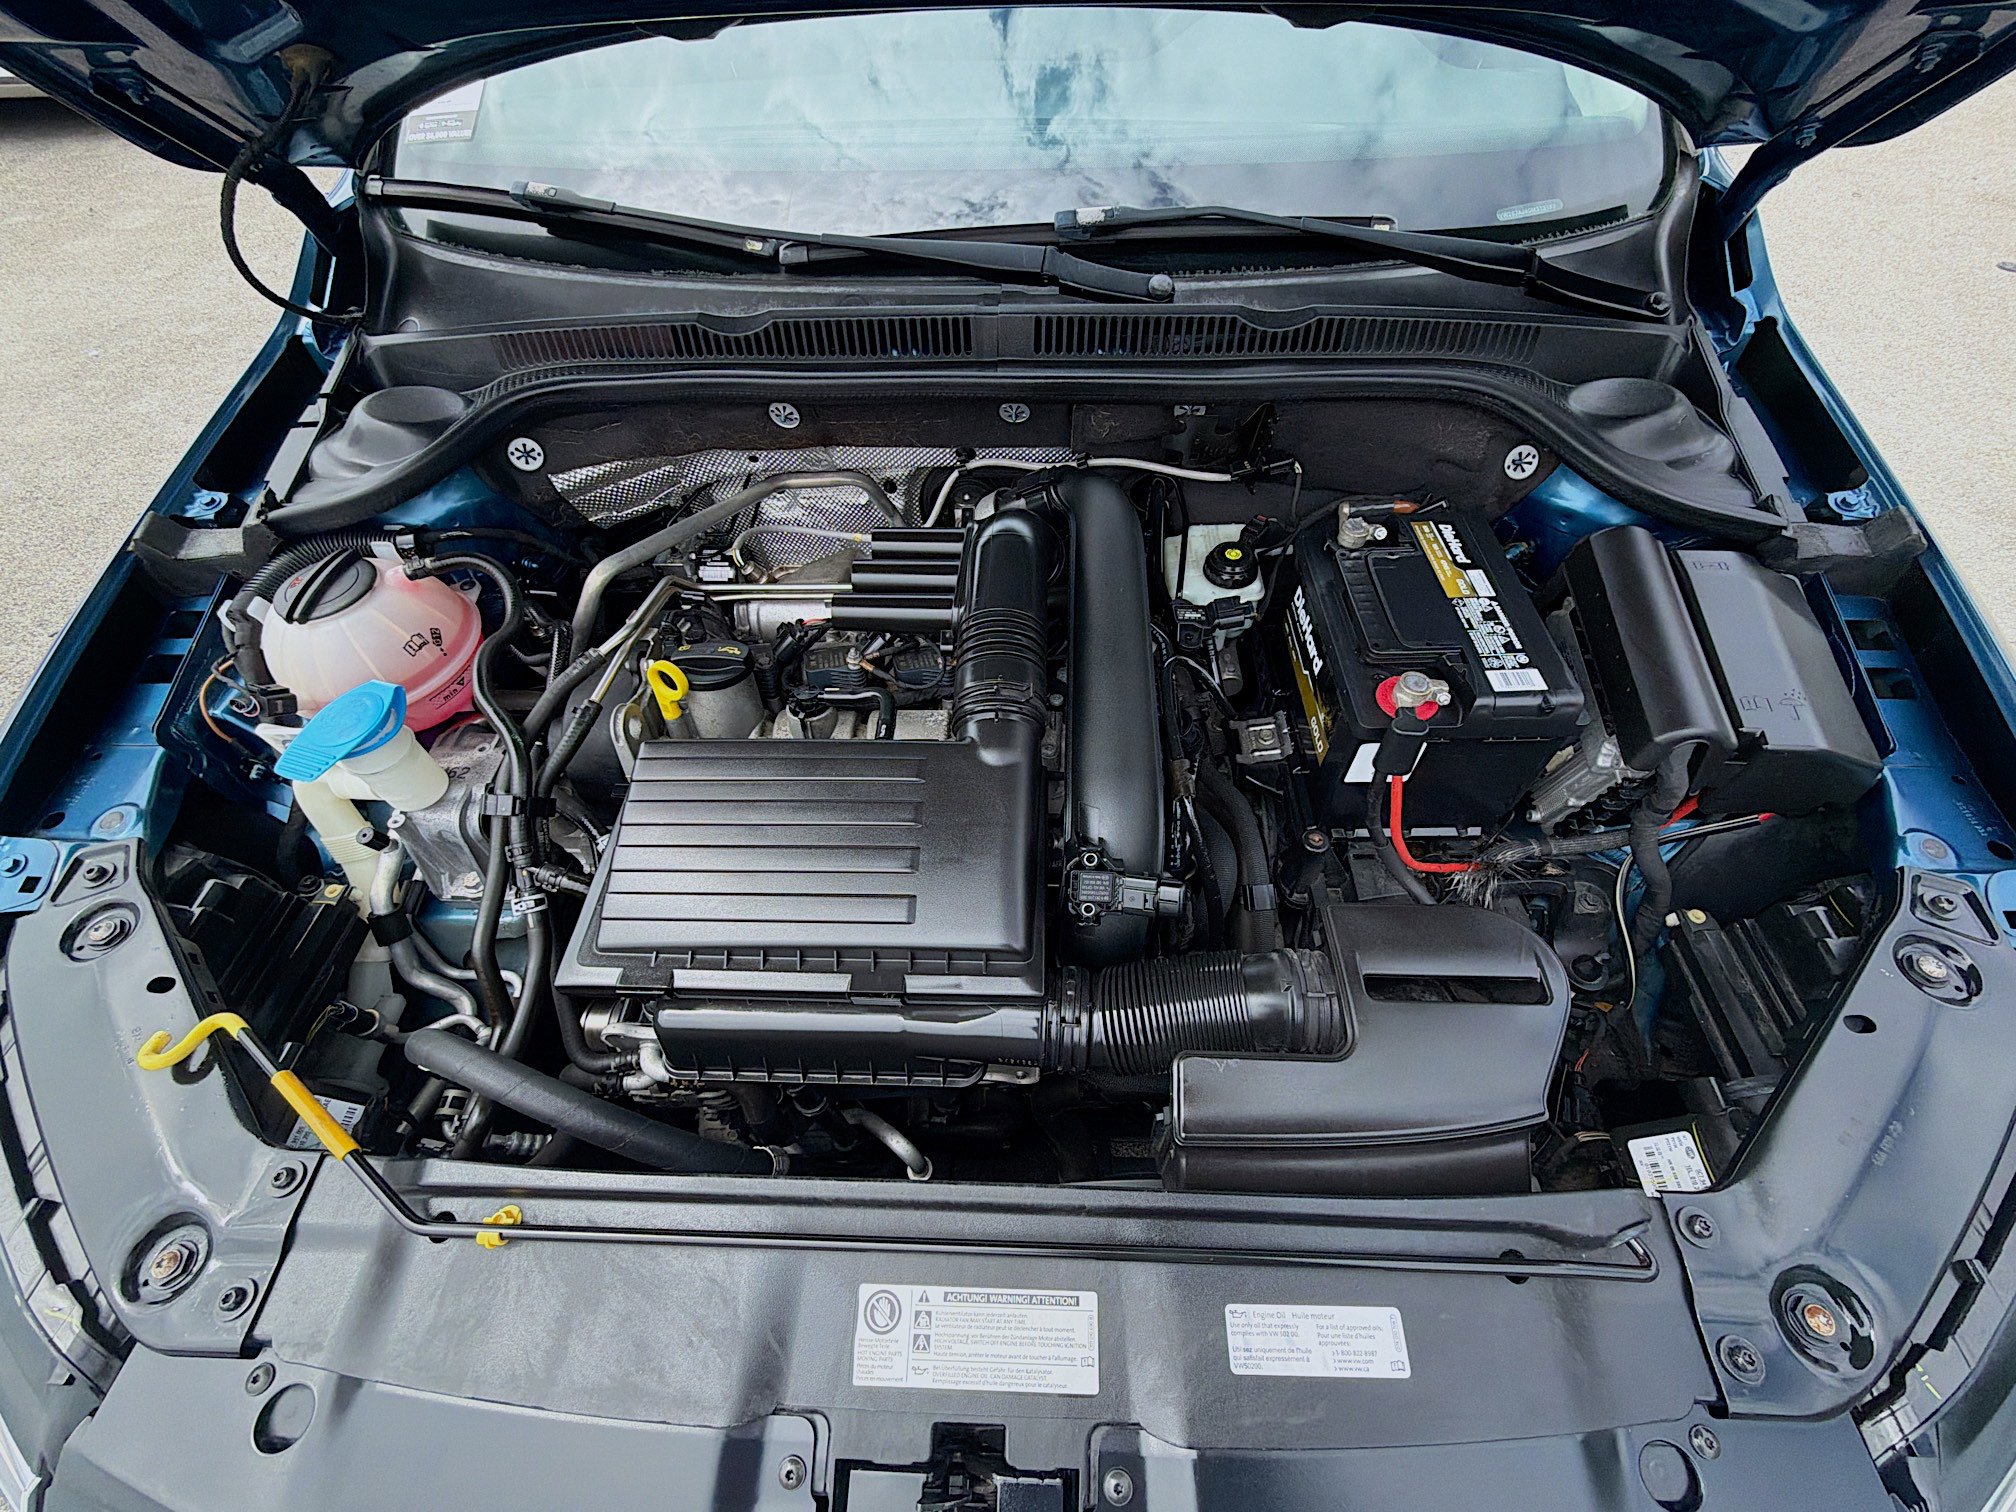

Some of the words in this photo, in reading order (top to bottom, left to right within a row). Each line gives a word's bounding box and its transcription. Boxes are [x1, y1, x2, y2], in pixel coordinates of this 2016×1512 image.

[1438, 524, 1471, 563] DieHard
[1456, 578, 1470, 595] GOLD
[1293, 585, 1324, 676] DieHard
[443, 688, 458, 702] min
[1310, 716, 1324, 753] GOLD
[947, 1293, 987, 1302] ACHTUNG!
[989, 1294, 1030, 1304] WARNING!
[1031, 1295, 1077, 1306] ATTENTION!
[1252, 1311, 1275, 1320] Engine
[1241, 1322, 1253, 1330] only
[1231, 1330, 1255, 1338] complies
